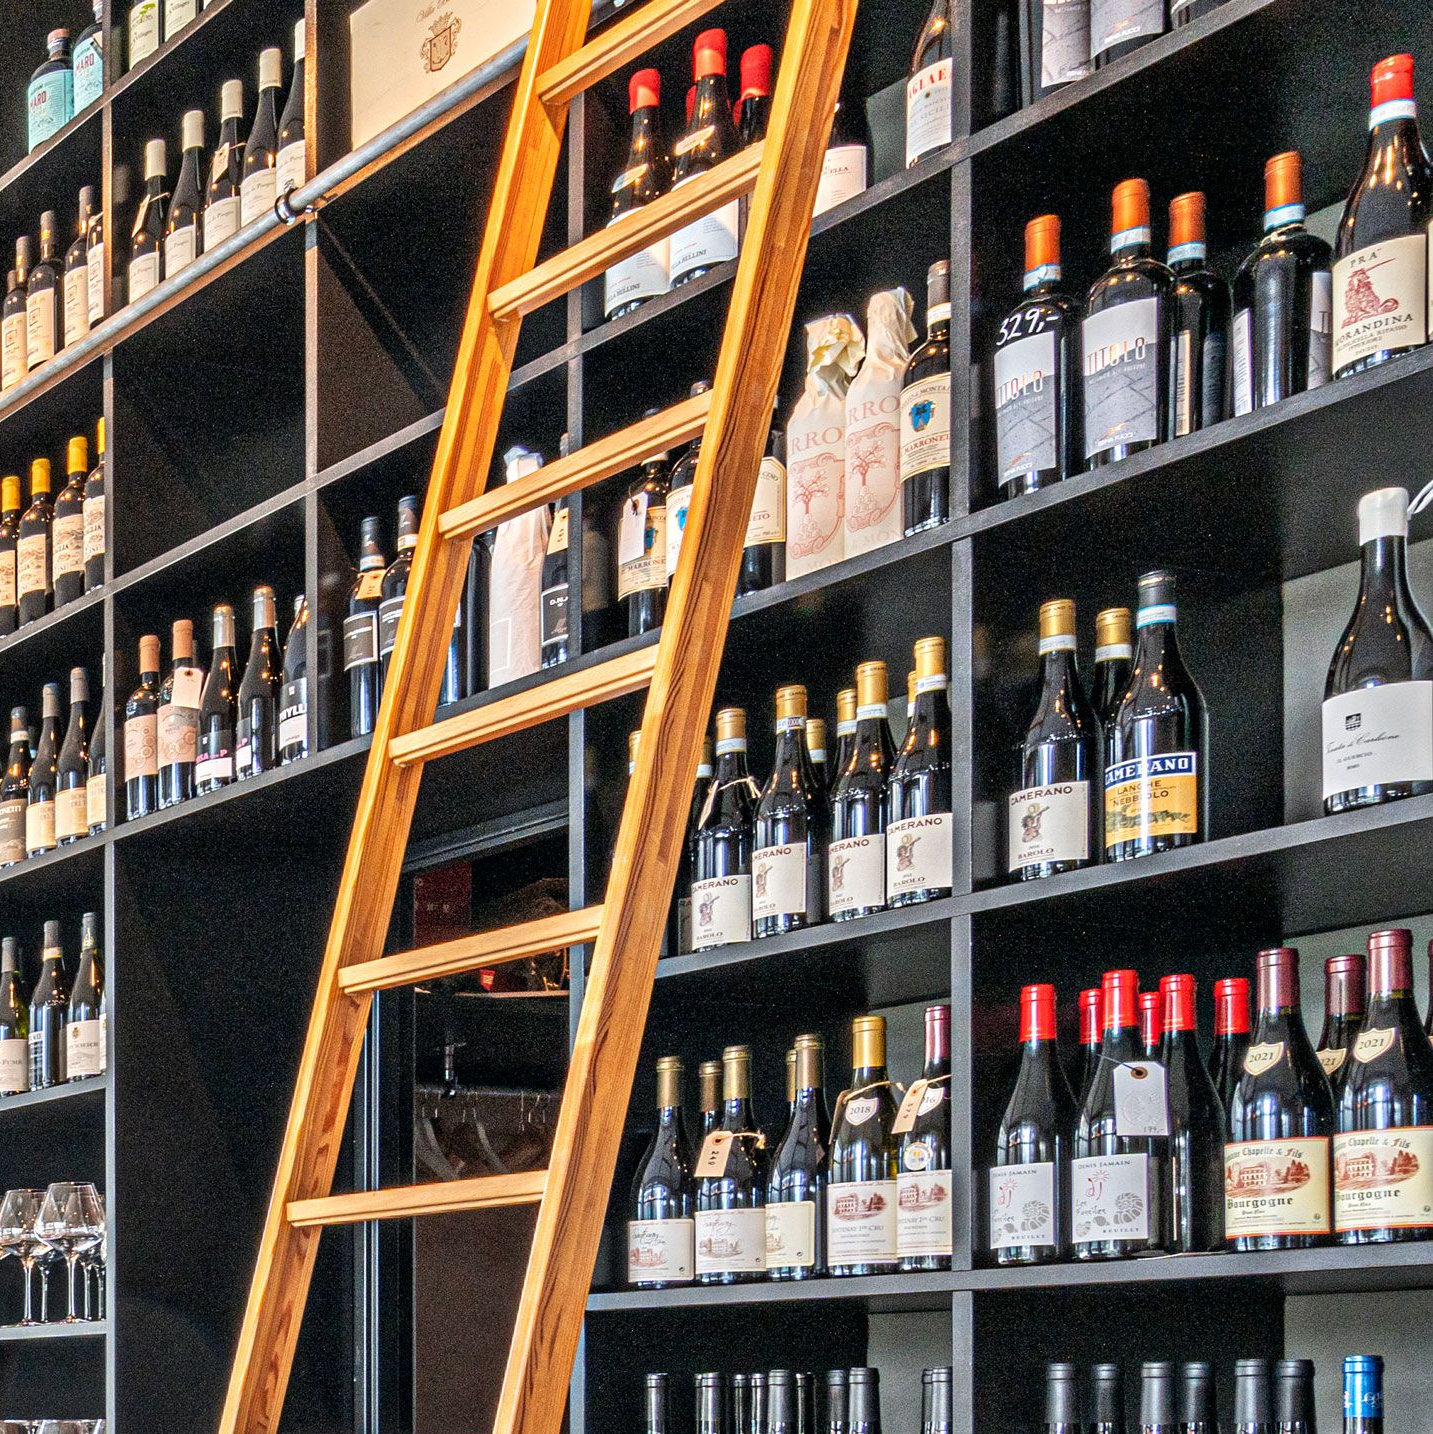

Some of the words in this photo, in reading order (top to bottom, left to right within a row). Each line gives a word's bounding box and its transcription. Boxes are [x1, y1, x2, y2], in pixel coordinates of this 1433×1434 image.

[1087, 336, 1146, 376] TITOLO
[1011, 785, 1073, 806] CAMERANO
[1113, 790, 1169, 807] NEBBOLO
[830, 838, 870, 854] MERANO
[754, 847, 792, 860] MERANO
[1017, 847, 1055, 861] BAROLO
[1359, 1038, 1384, 1050] 2021
[1249, 1052, 1274, 1064] 2021
[1320, 1057, 1336, 1066] 021
[925, 1095, 937, 1104] 16
[848, 1105, 871, 1117] 2018
[1283, 1147, 1304, 1159] Fils
[1099, 1160, 1131, 1168] JAMAIN
[1009, 1169, 1038, 1178] JAMAIN
[1335, 1189, 1401, 1202] Bourgogne
[1227, 1197, 1294, 1210] Bourgogne
